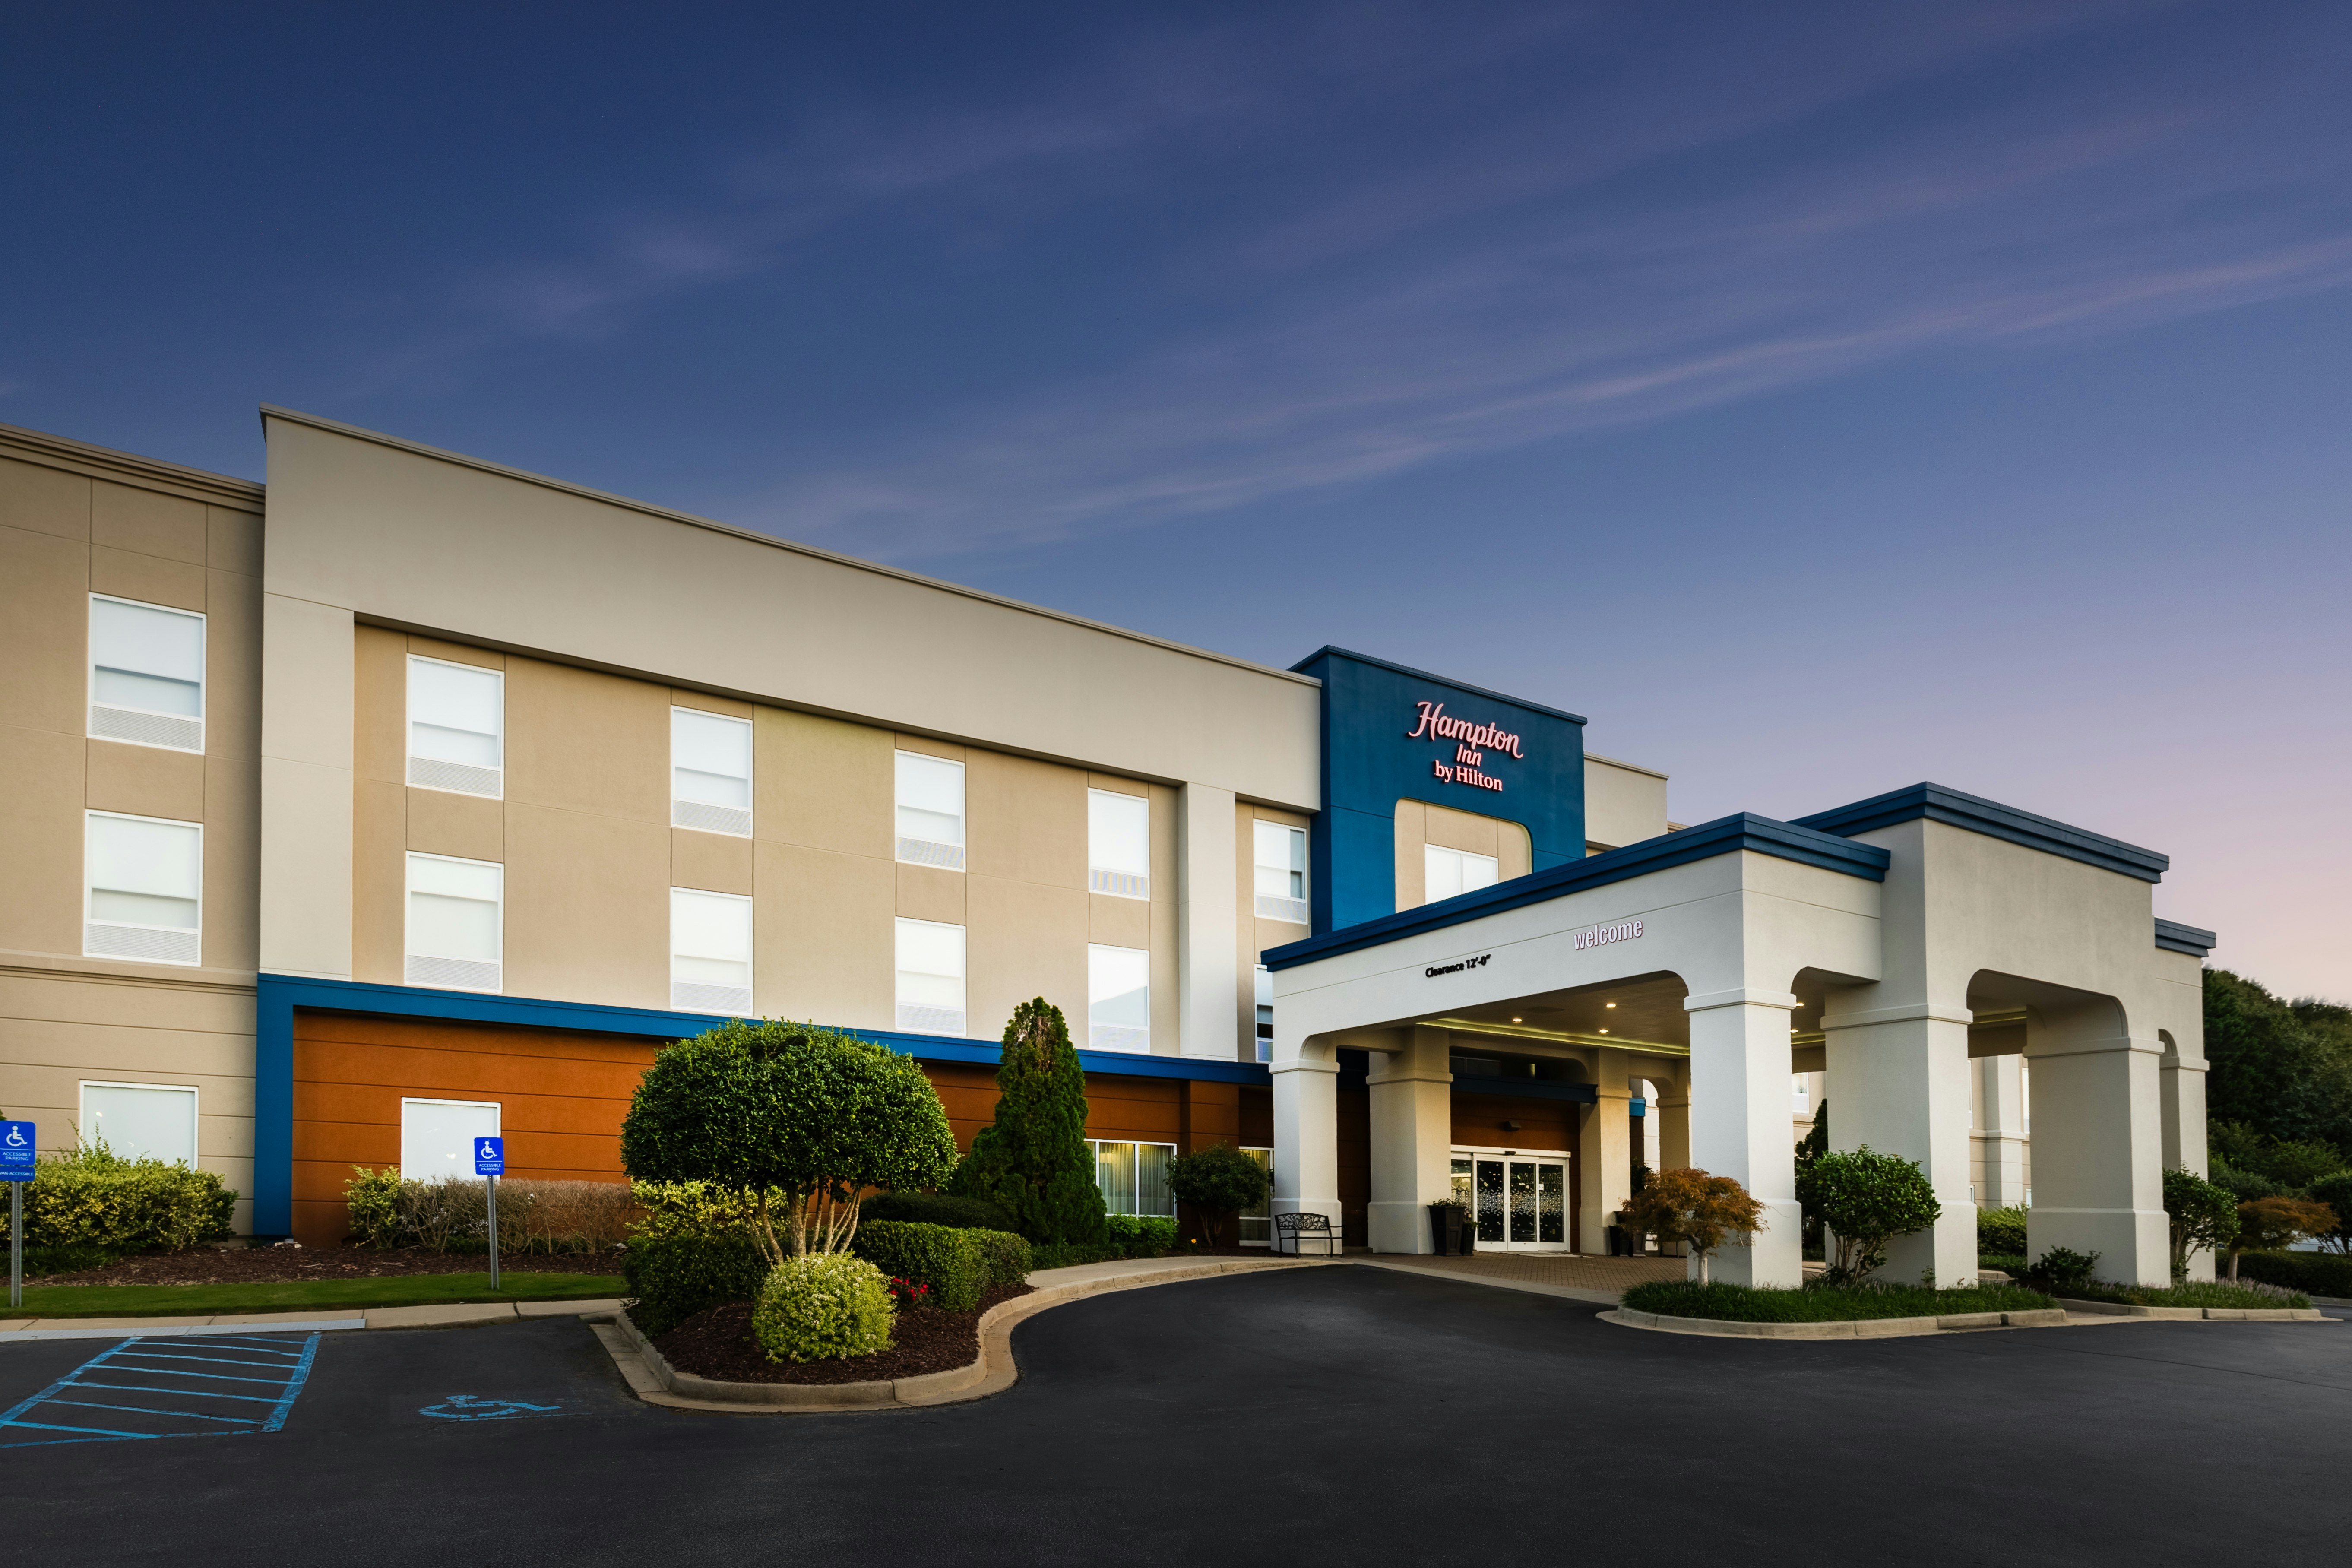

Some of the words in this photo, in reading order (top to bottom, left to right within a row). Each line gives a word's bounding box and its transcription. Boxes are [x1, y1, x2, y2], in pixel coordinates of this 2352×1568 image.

[1408, 701, 1523, 759] Hampton
[1456, 744, 1482, 767] Inn
[1434, 760, 1453, 783] by
[1456, 766, 1503, 791] Hilton
[1574, 920, 1643, 950] welcome
[1425, 963, 1465, 978] Clearance
